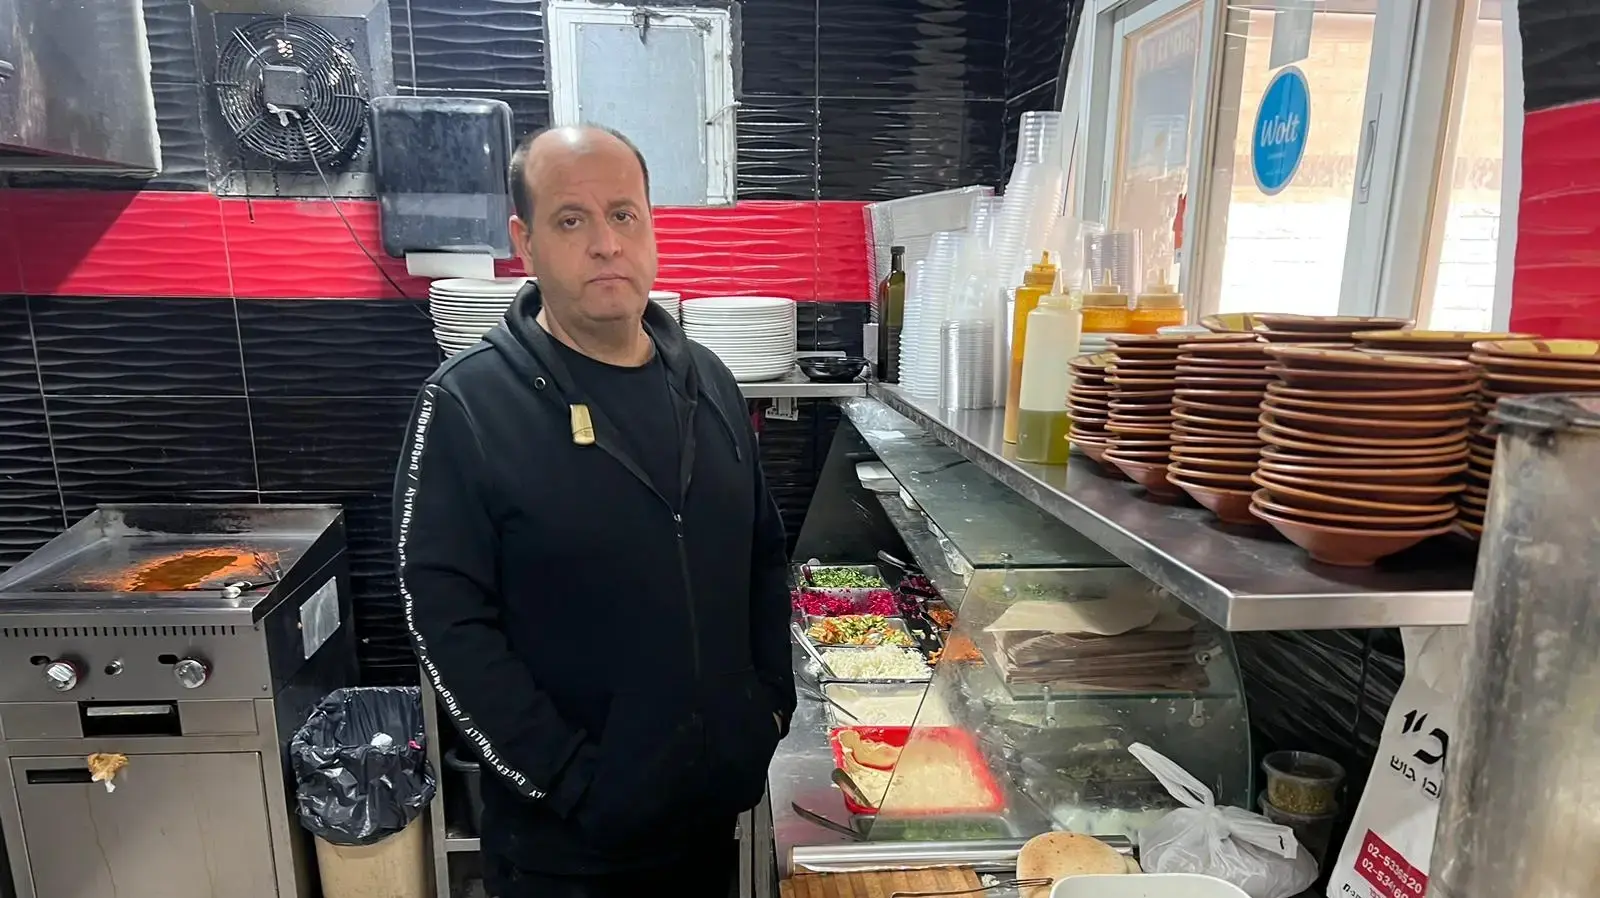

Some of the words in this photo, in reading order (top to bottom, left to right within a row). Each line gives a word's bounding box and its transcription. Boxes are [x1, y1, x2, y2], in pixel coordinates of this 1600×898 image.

[1261, 112, 1300, 148] Wolt
[409, 399, 433, 471] UNCOMMONLY
[397, 487, 417, 568] EXCEPTIONALLY
[420, 655, 461, 717] UNCOMMONLY
[465, 727, 526, 786] EXCEPTIONALLY
[1390, 755, 1416, 782] גוש
